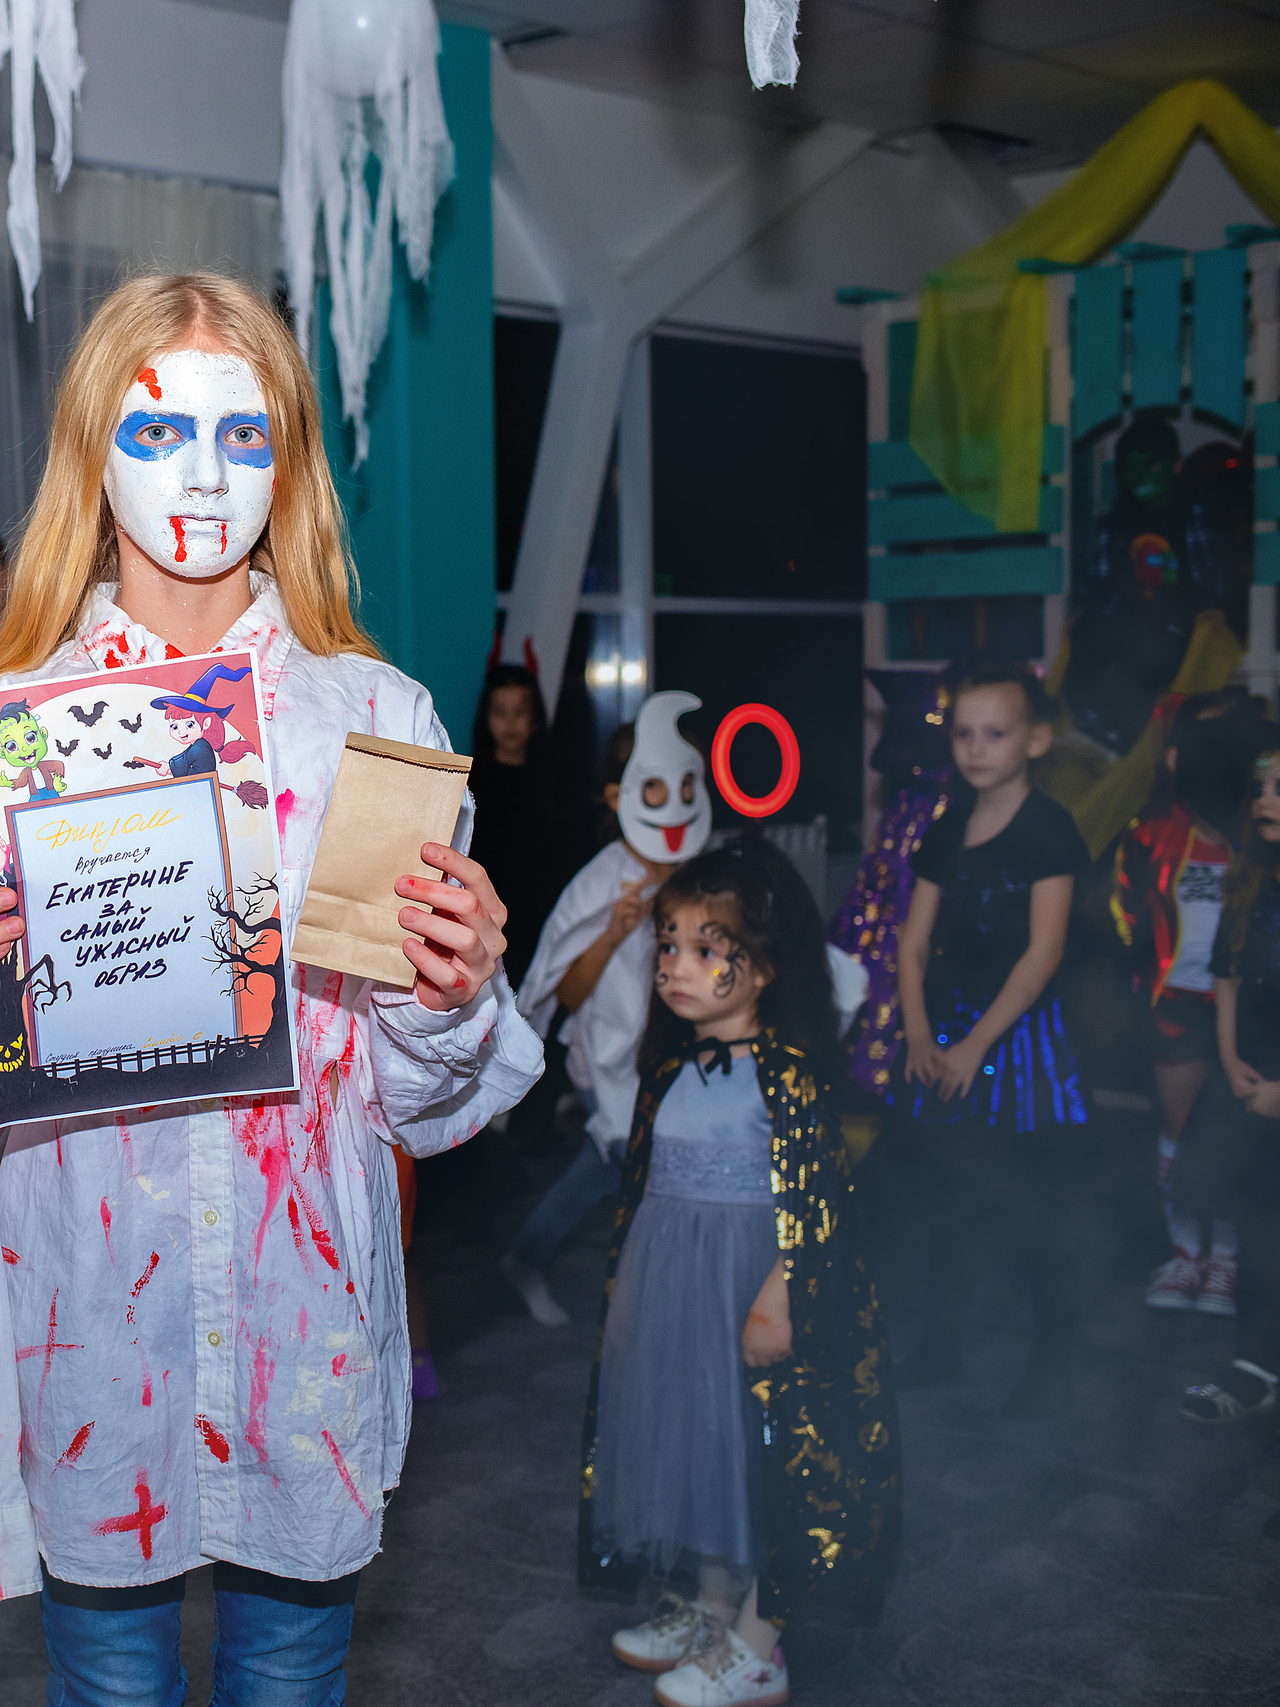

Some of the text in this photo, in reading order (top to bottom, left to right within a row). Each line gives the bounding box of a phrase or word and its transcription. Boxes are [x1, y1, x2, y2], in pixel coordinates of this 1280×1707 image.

[35, 808, 187, 853] Диплом
[46, 860, 194, 910] ЕКАТЕРИНЕ
[60, 906, 152, 942] САМЫЙ
[98, 899, 134, 919] ЗА
[75, 915, 195, 967] УЖАСНЫЙ
[94, 958, 168, 988] ОБРАЗ
